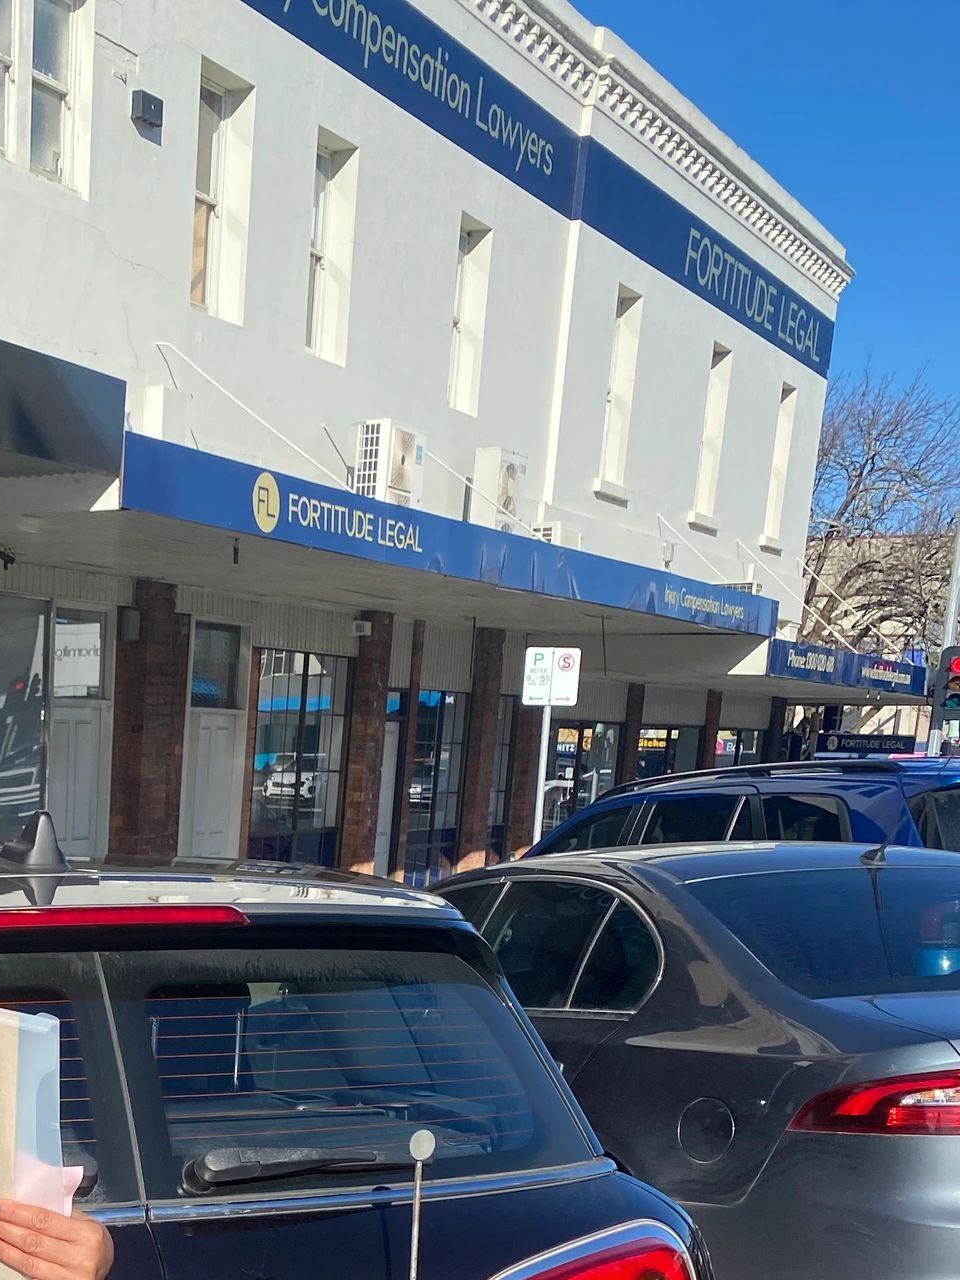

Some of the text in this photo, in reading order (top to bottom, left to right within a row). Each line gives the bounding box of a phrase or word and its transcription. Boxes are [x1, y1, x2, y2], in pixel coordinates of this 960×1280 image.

[475, 76, 554, 176] Lawyers
[684, 227, 820, 362] FORTITUDE LEGAL
[288, 492, 374, 542] FORTITUDE
[377, 516, 423, 553] LEGAL
[664, 583, 744, 623] Injury Compensation Lawyers
[533, 652, 545, 666] P
[841, 738, 880, 749] FORTITUDE
[882, 740, 905, 750] LEGAL
